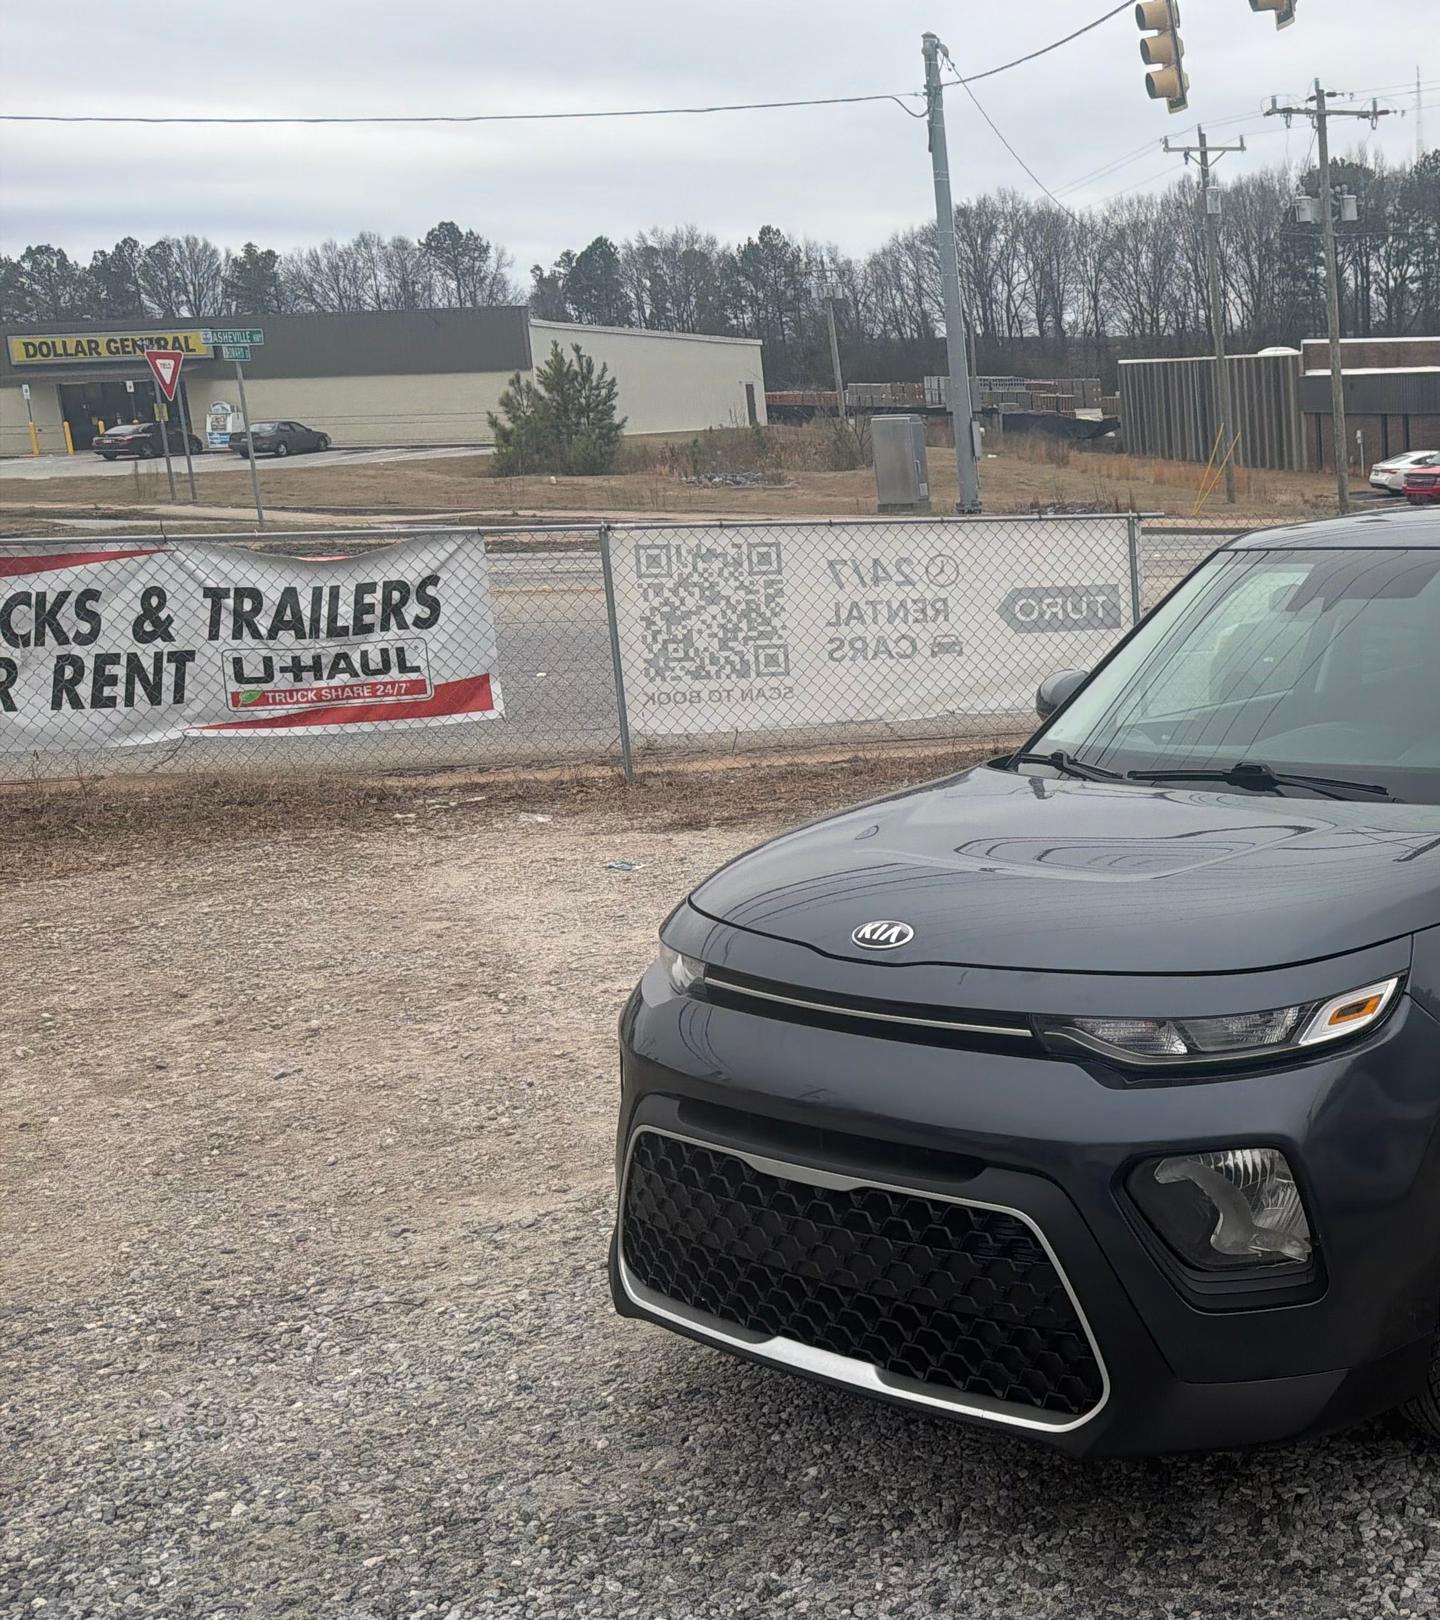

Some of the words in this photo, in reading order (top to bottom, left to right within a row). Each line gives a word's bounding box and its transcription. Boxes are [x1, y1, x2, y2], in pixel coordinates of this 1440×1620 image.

[213, 331, 251, 343] ASHEVILLE
[22, 339, 102, 359] DOLLAR
[0, 588, 102, 649] CKS
[132, 585, 176, 645] &
[202, 574, 442, 642] TRAILERS
[232, 647, 421, 685] U-HAUL
[50, 650, 196, 711] RENT
[265, 690, 316, 704] TRUCK
[320, 686, 373, 702] SHARE
[376, 682, 409, 696] 24/7
[857, 923, 902, 944] KIA
